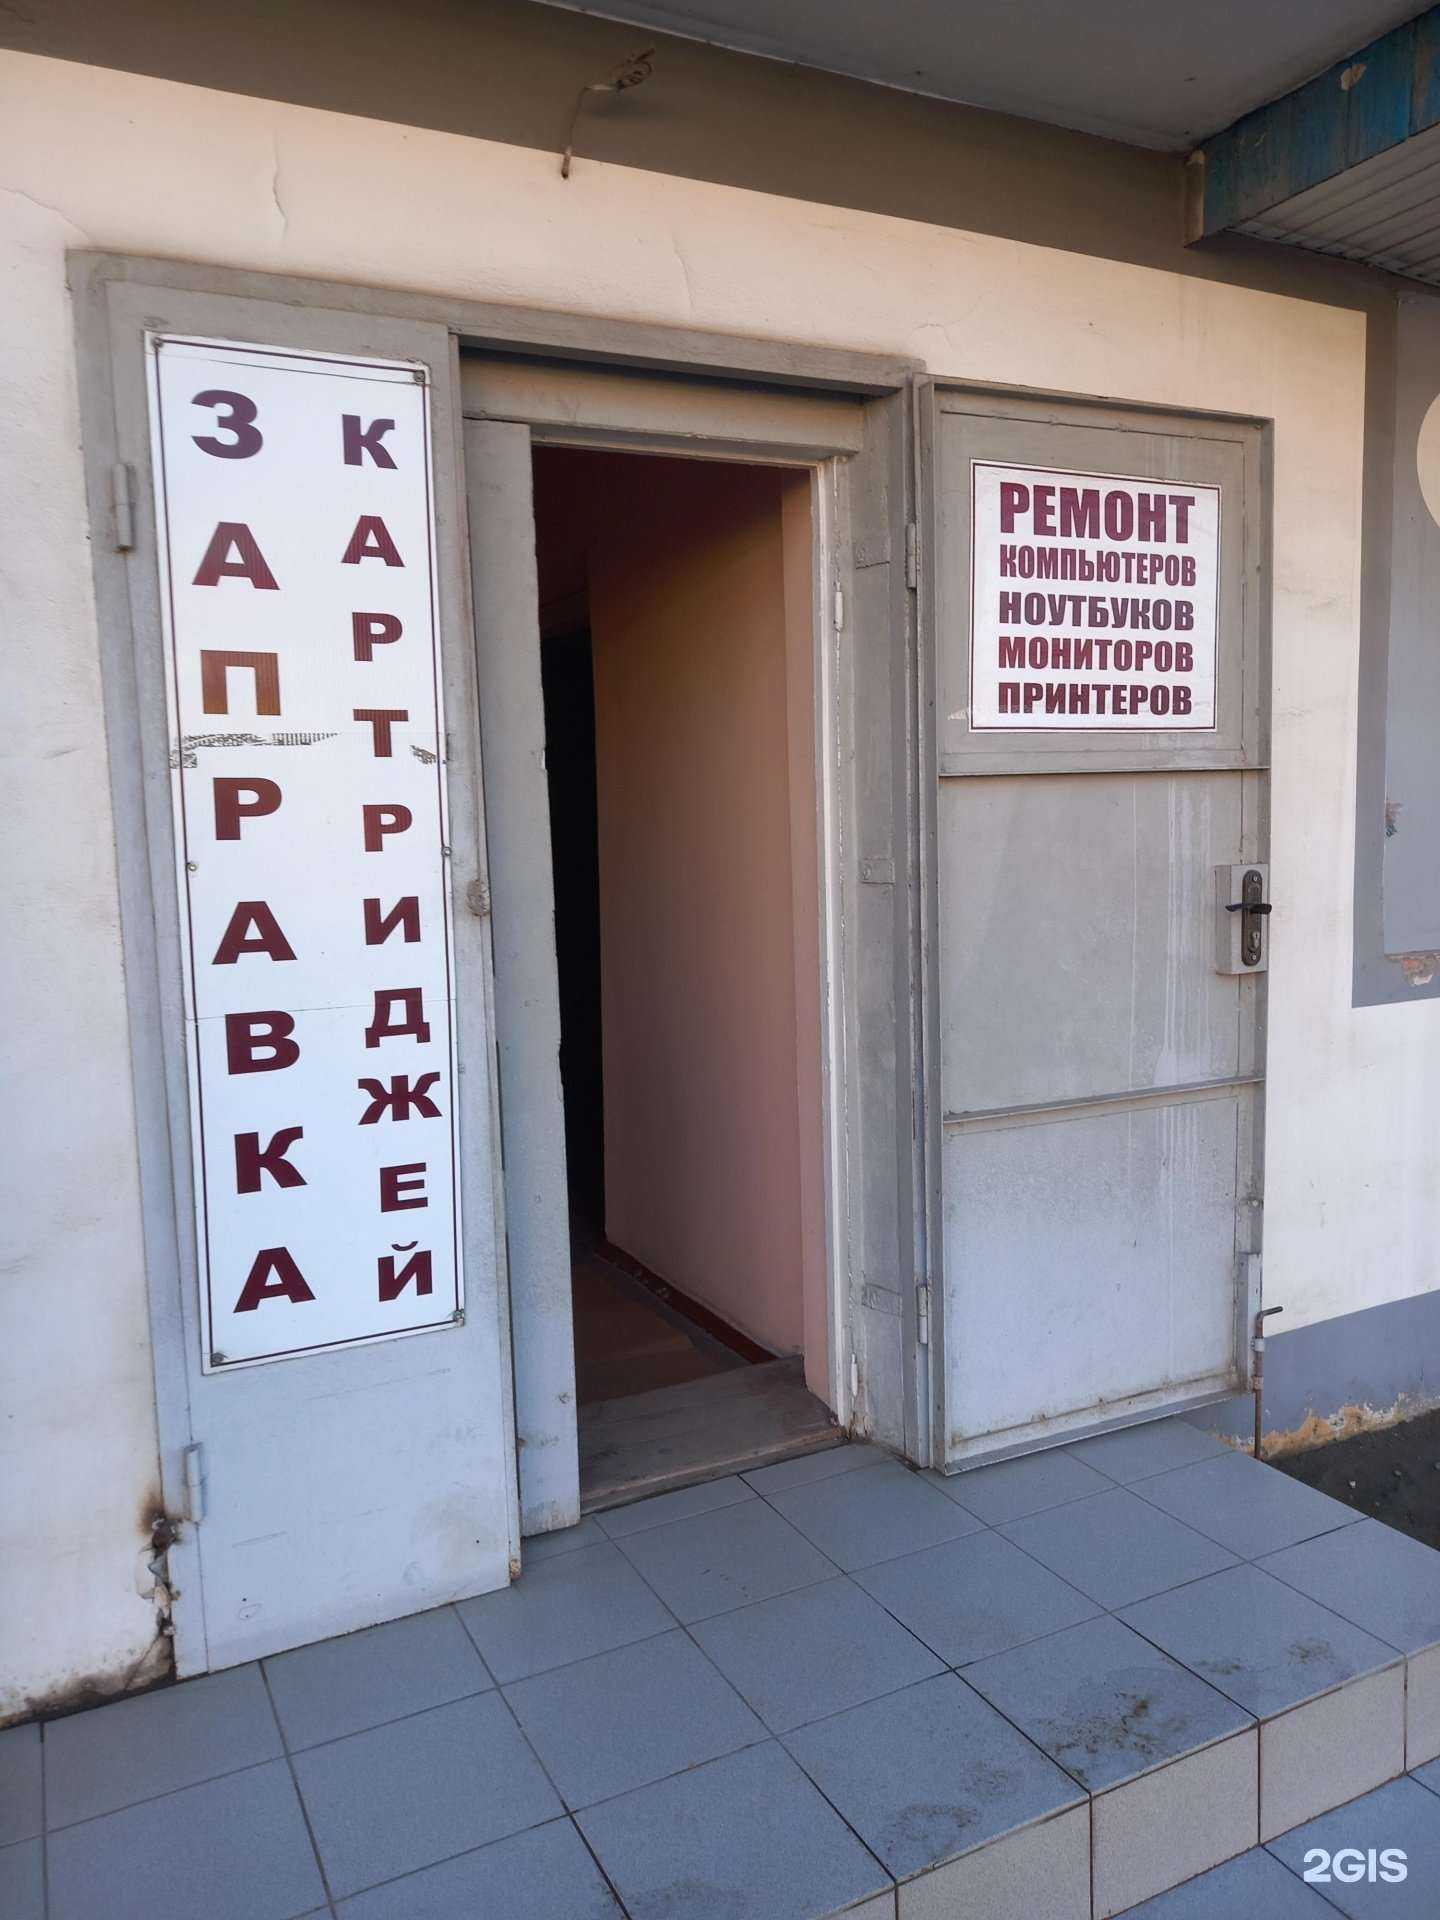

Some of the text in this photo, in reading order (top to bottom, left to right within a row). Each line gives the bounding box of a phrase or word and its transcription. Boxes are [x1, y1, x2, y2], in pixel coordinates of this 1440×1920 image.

[1000, 481, 1196, 544] РЕМОНТ
[1000, 544, 1197, 587] КОМПЬЮТЕРОВ
[999, 591, 1194, 631] НОУТБУКОВ
[998, 636, 1194, 673] МОНИТОРОВ
[998, 682, 1192, 716] ПРИНТЕРОВ
[191, 389, 317, 1314] ЗАПРАВКА
[341, 413, 443, 1302] КАРТРИДЖЕЙ
